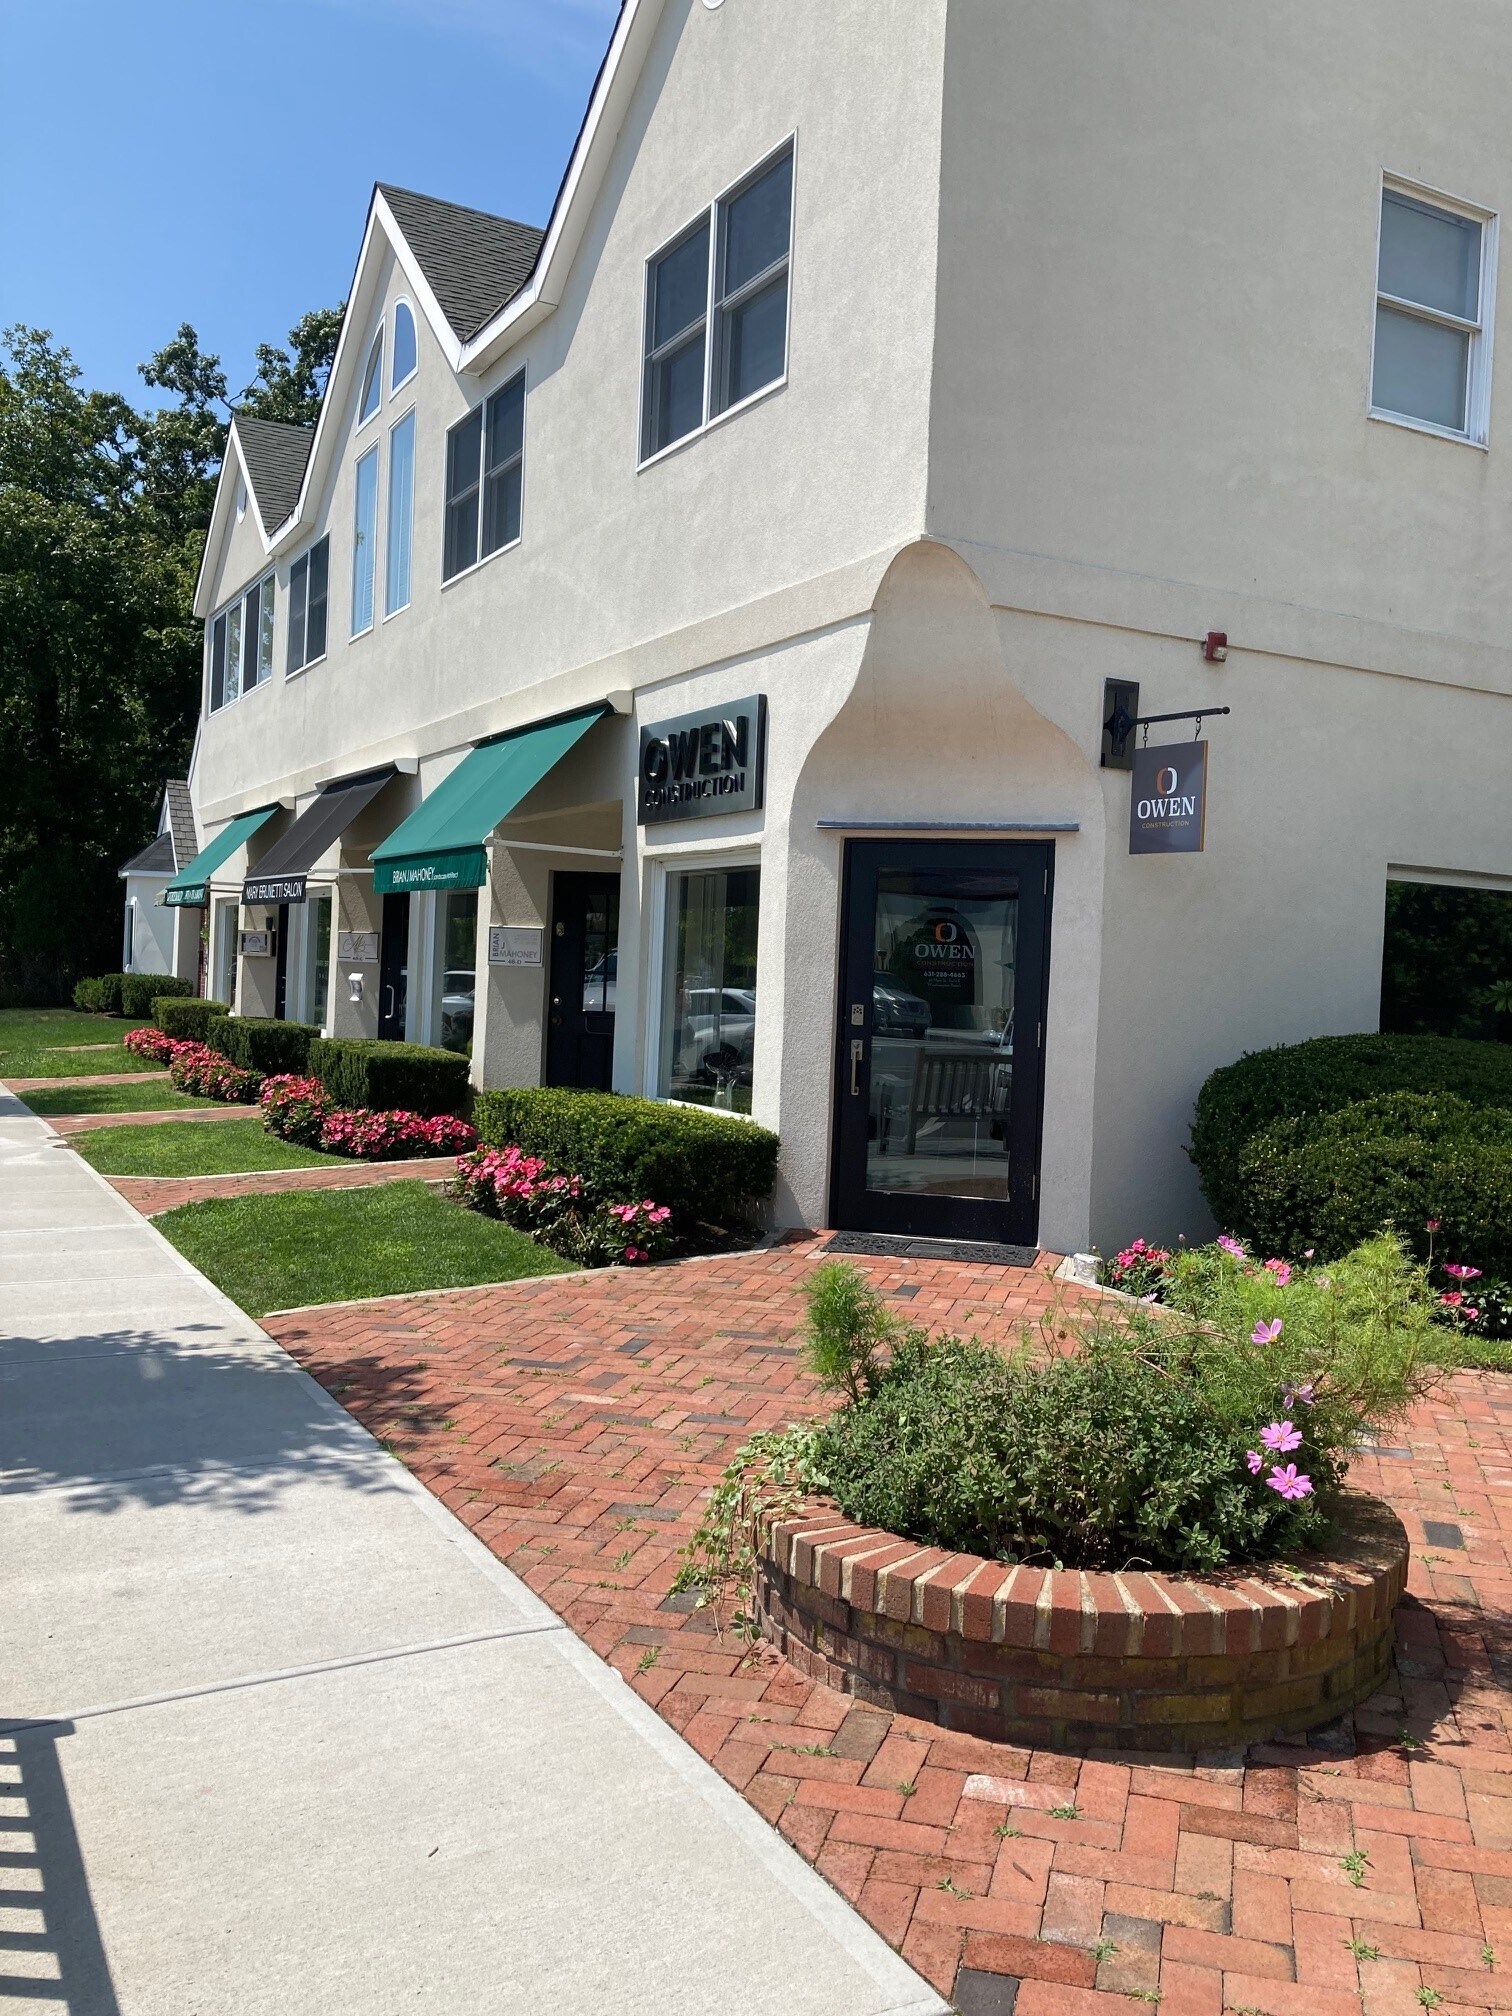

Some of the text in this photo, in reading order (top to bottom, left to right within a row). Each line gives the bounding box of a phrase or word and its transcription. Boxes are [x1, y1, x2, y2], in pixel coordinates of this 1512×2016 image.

[644, 715, 749, 784] OWEN
[645, 772, 745, 809] CONSTRUCTION
[1137, 796, 1196, 819] OWEN
[1141, 820, 1190, 829] CONSTRUCTION
[283, 881, 303, 897] SALON
[492, 933, 500, 957] BRIAN
[499, 950, 538, 959] MAHONEY
[914, 943, 977, 959] OWEN
